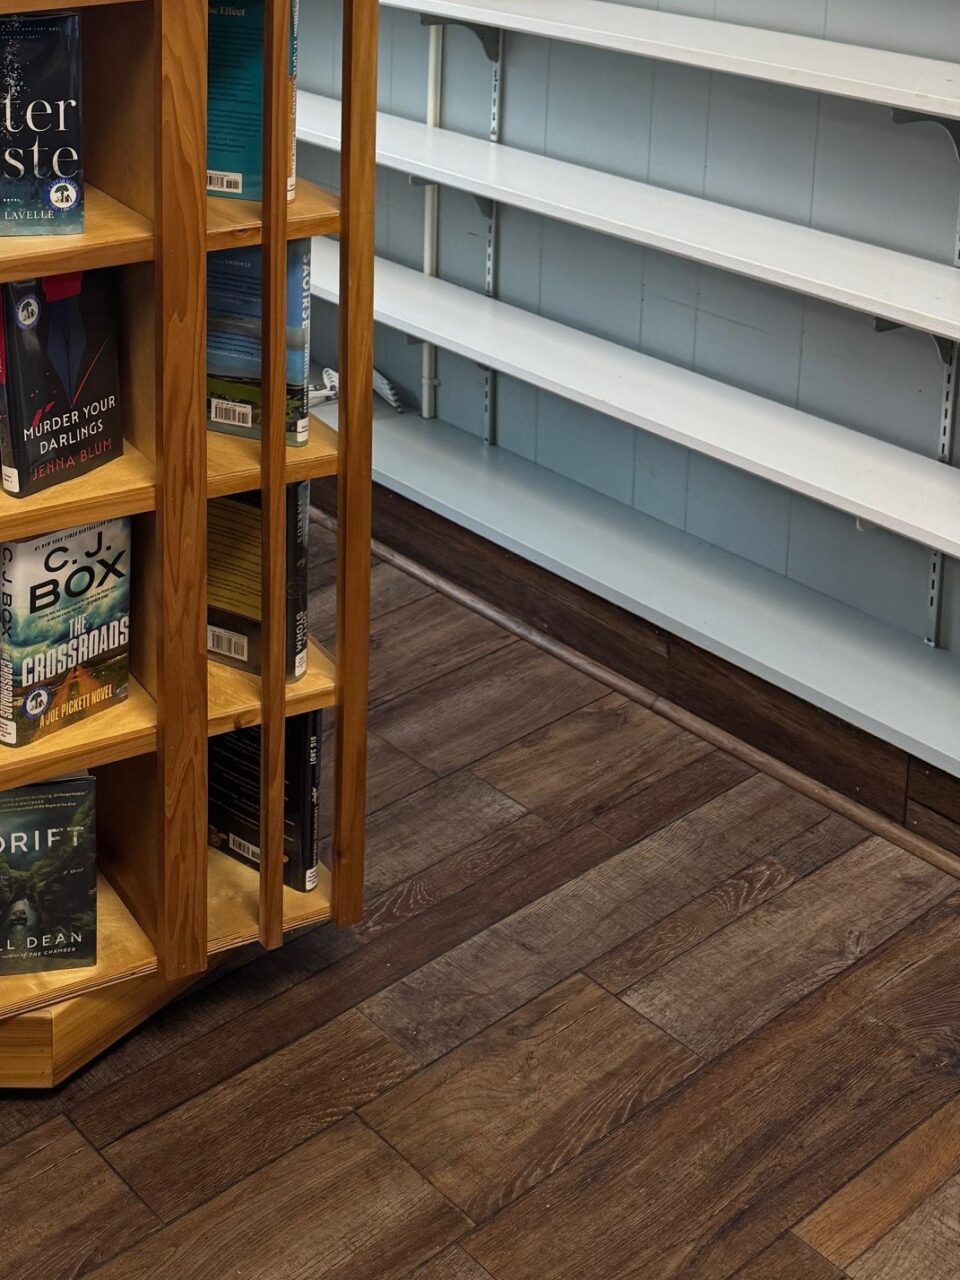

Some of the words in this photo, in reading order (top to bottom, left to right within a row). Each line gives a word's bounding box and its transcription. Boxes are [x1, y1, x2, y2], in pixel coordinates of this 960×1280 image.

[4, 209, 55, 219] LAVELLE
[301, 255, 310, 329] SAOIRSE
[23, 409, 79, 442] MURDER
[83, 395, 116, 420] YOUR
[40, 419, 104, 455] DARLINGS
[31, 455, 75, 481] JENNA
[80, 437, 113, 463] BLUM
[2, 547, 13, 567] C.
[44, 546, 78, 573] C.
[84, 531, 112, 558] J.
[1, 570, 13, 587] J.
[29, 549, 127, 614] BOX
[1, 591, 13, 639] BOX
[68, 613, 88, 639] THE
[295, 611, 304, 652] STORM
[22, 615, 130, 688] CROSSROADS
[0, 660, 13, 719] CROSSROADS
[39, 714, 45, 729] A
[45, 707, 59, 726] JOE
[61, 695, 90, 719] PICKETT
[90, 683, 113, 706] NOVEL
[309, 736, 317, 748] BIG
[309, 749, 317, 765] SHOT
[26, 932, 82, 948] DEAN
